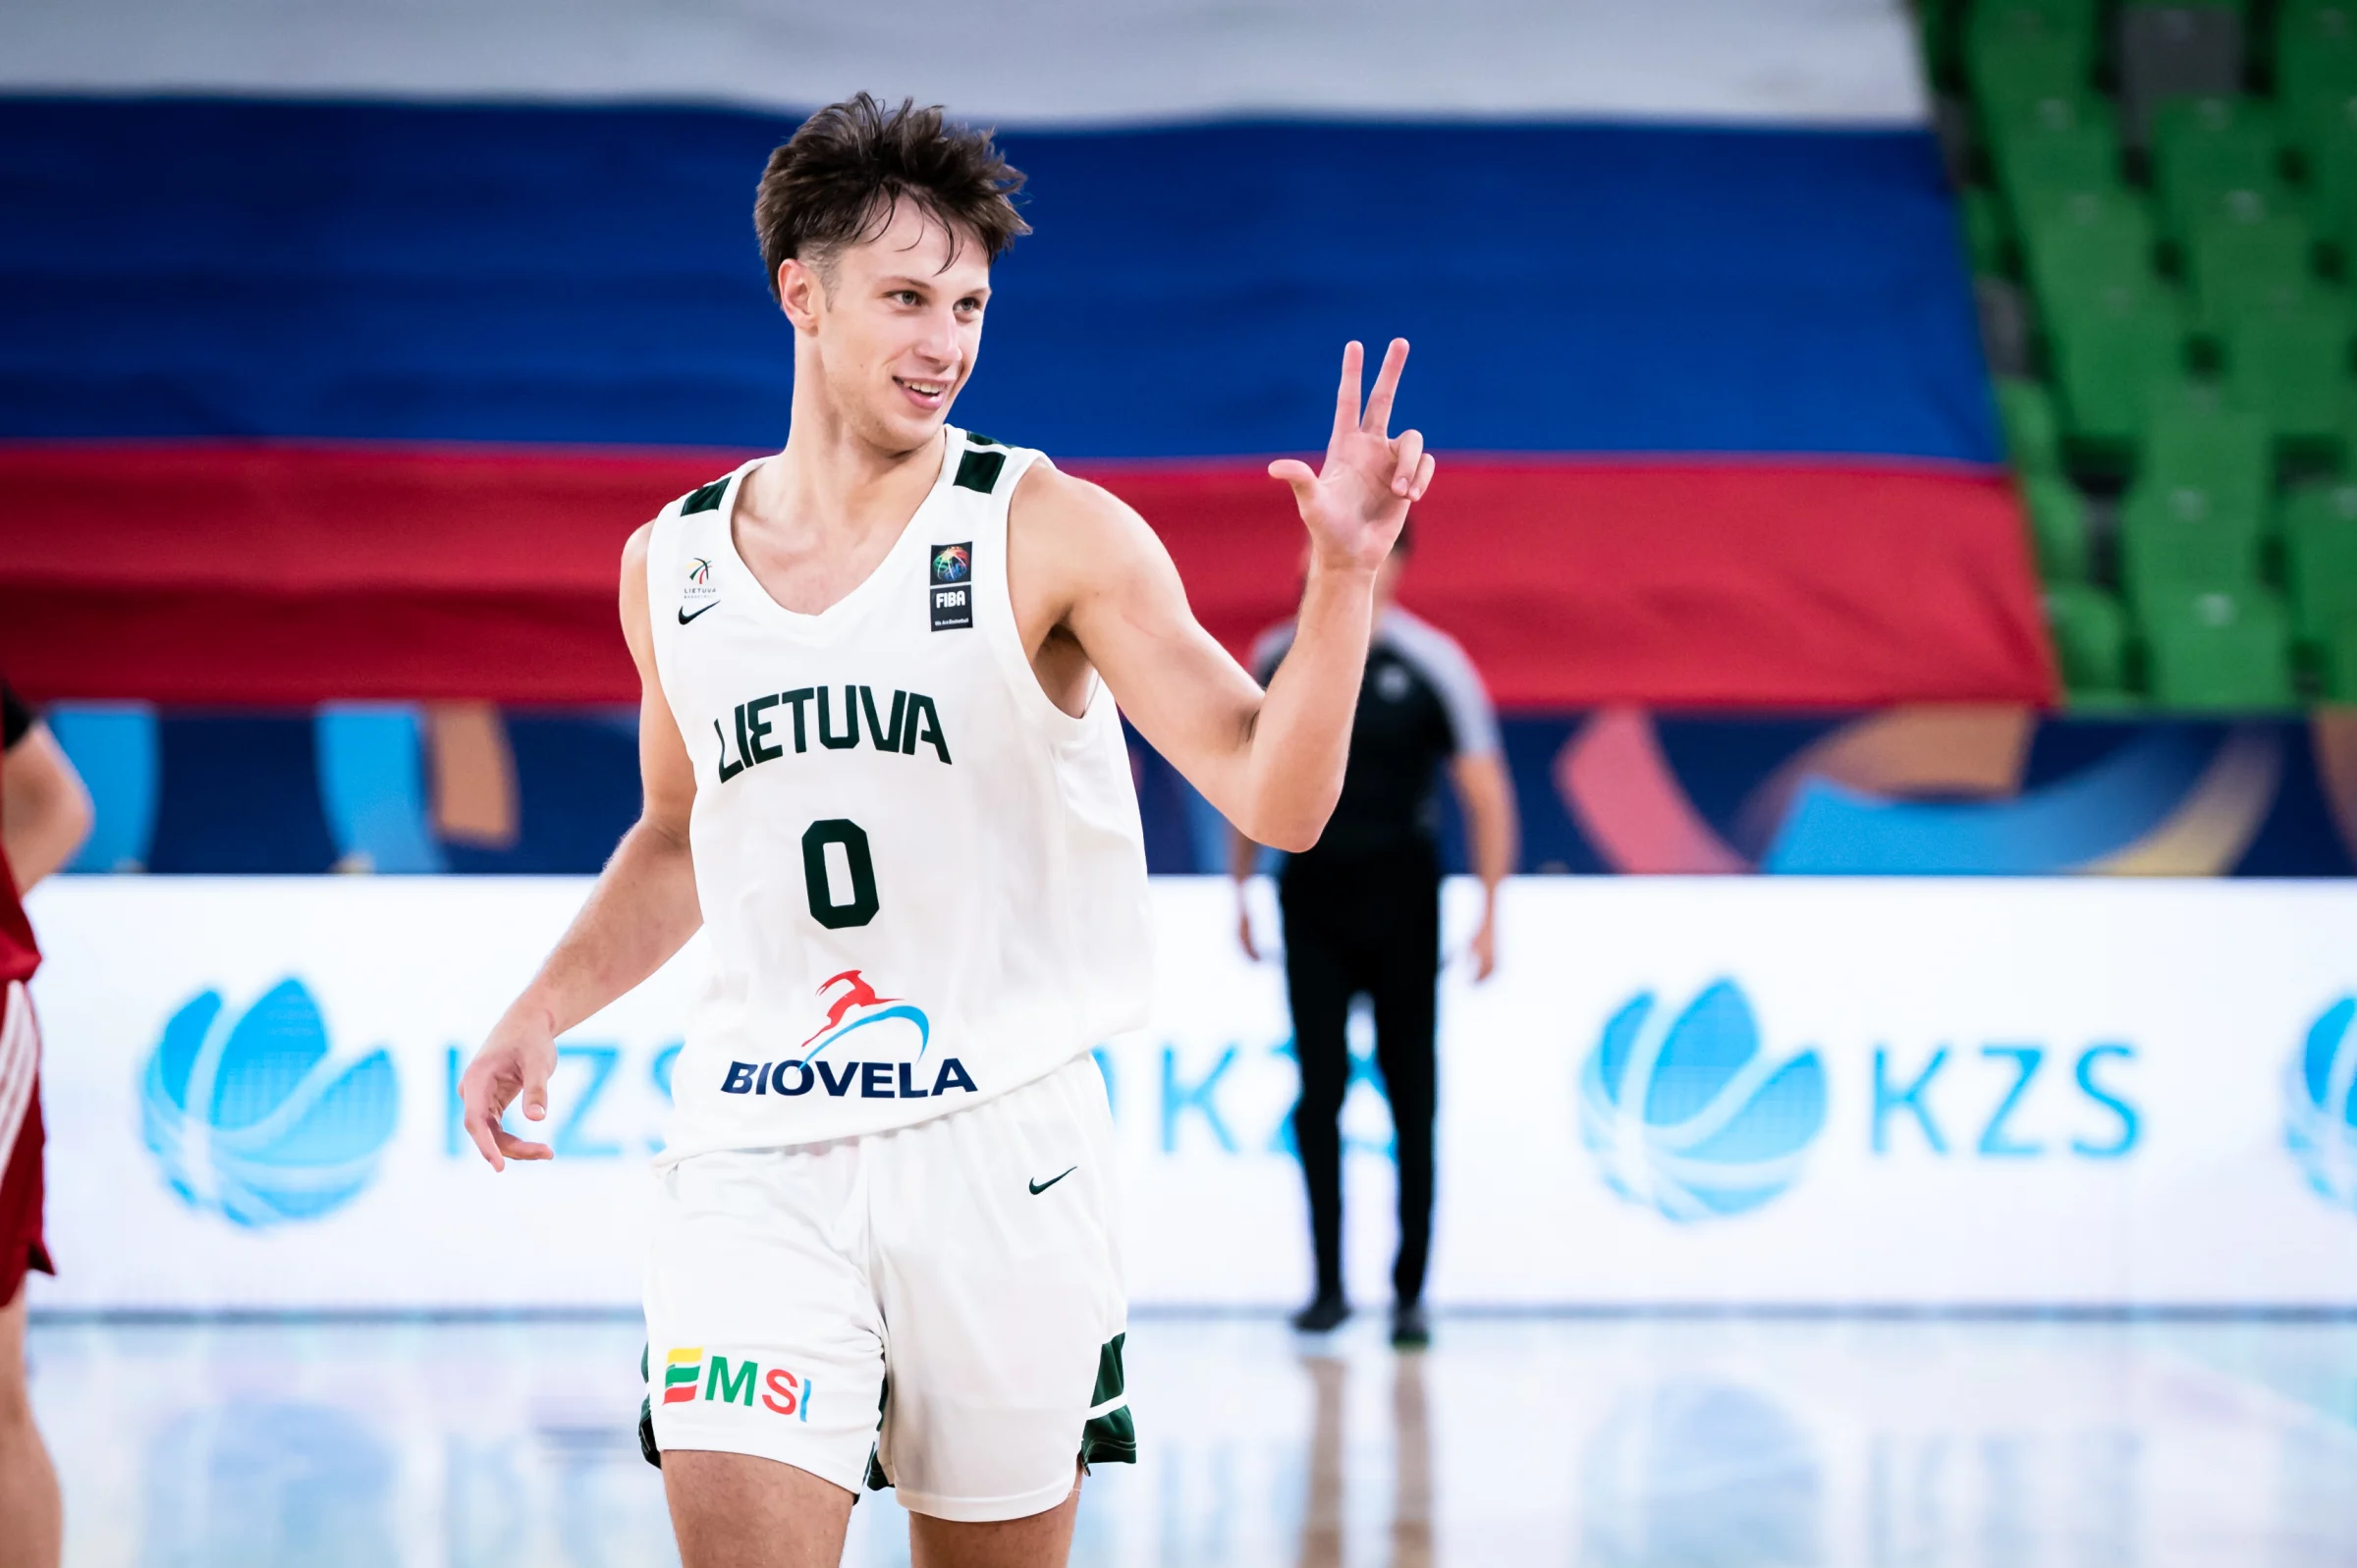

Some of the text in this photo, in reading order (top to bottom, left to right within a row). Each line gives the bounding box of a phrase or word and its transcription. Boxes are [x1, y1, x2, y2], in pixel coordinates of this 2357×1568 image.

[936, 590, 966, 609] FIBA
[713, 684, 953, 784] LIETUVA
[801, 819, 880, 929] 0
[721, 1057, 978, 1099] BIOVELA
[1870, 1044, 2141, 1159] KZS
